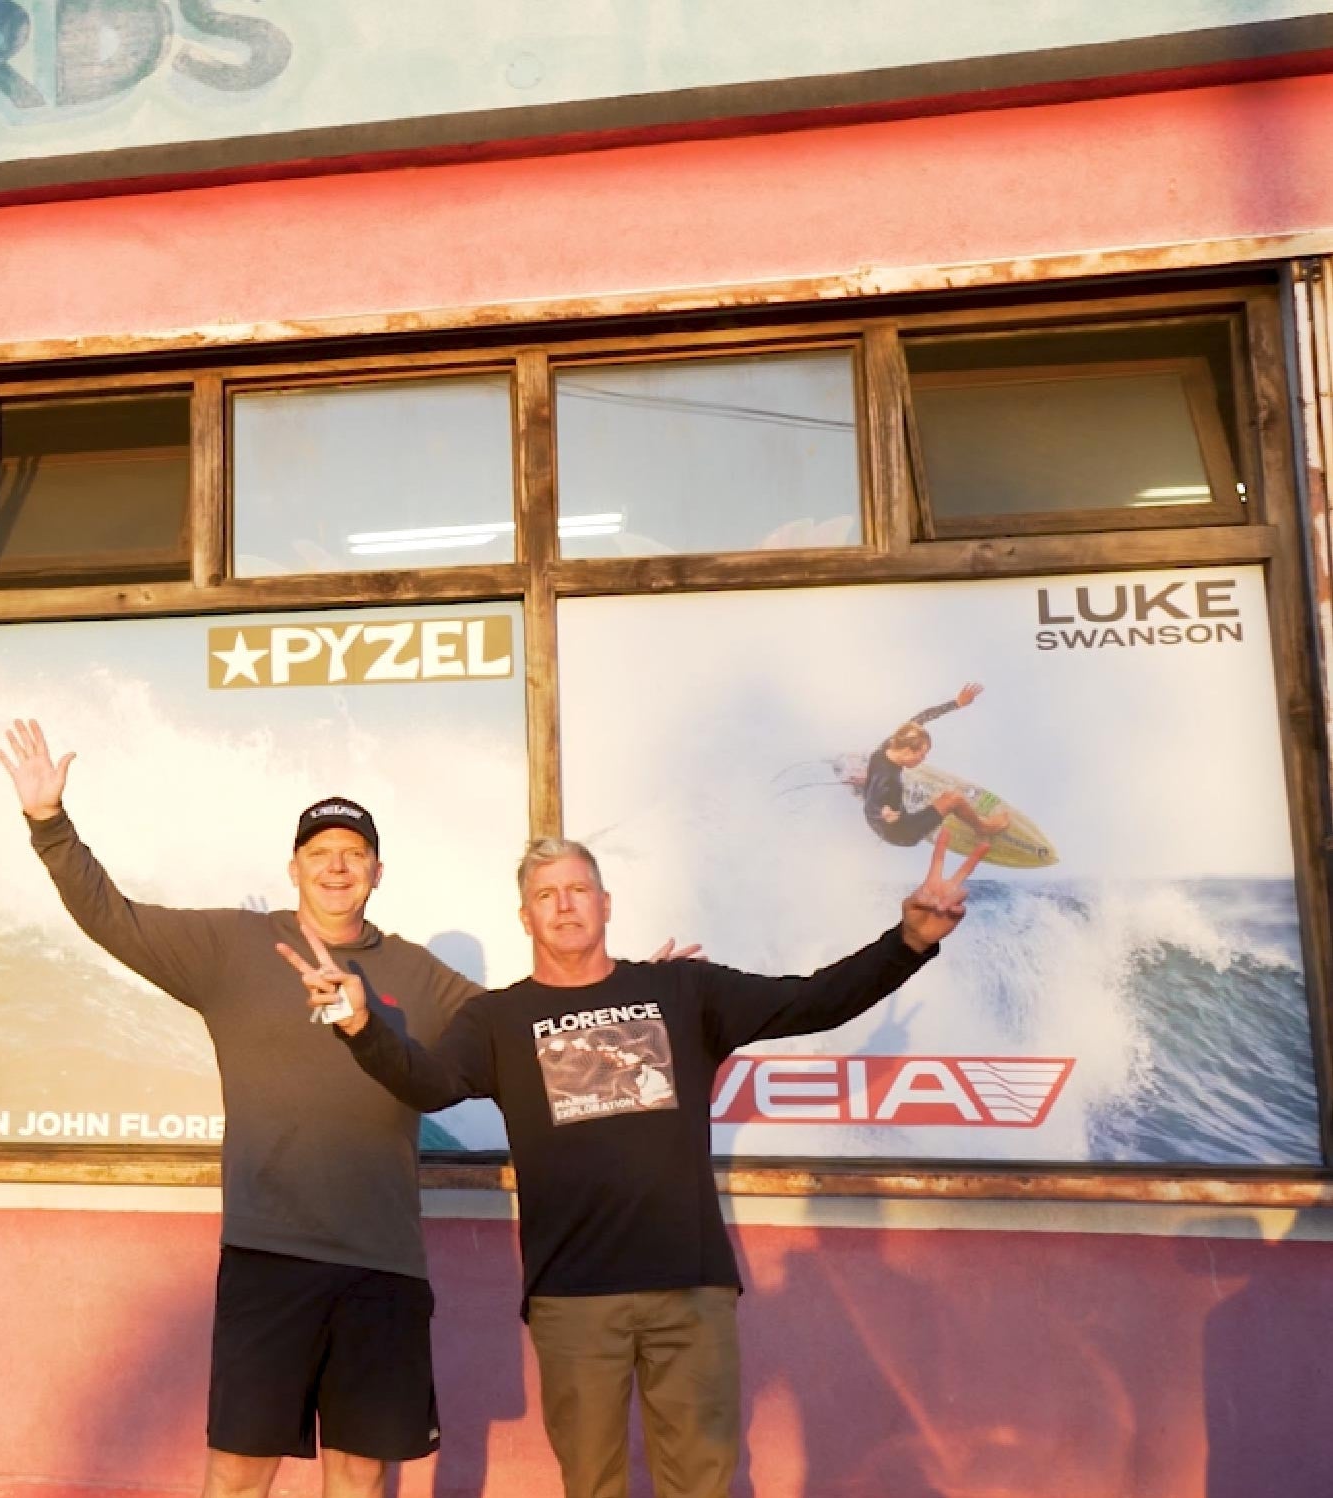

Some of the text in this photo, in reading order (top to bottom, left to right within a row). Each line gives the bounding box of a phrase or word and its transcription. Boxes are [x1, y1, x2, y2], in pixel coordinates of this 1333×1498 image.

[1037, 579, 1240, 625] LUKE
[270, 620, 512, 684] PYZEL
[1035, 622, 1244, 651] SWANSON
[532, 1002, 663, 1039] FLORENCE
[17, 1110, 109, 1138] JOHN
